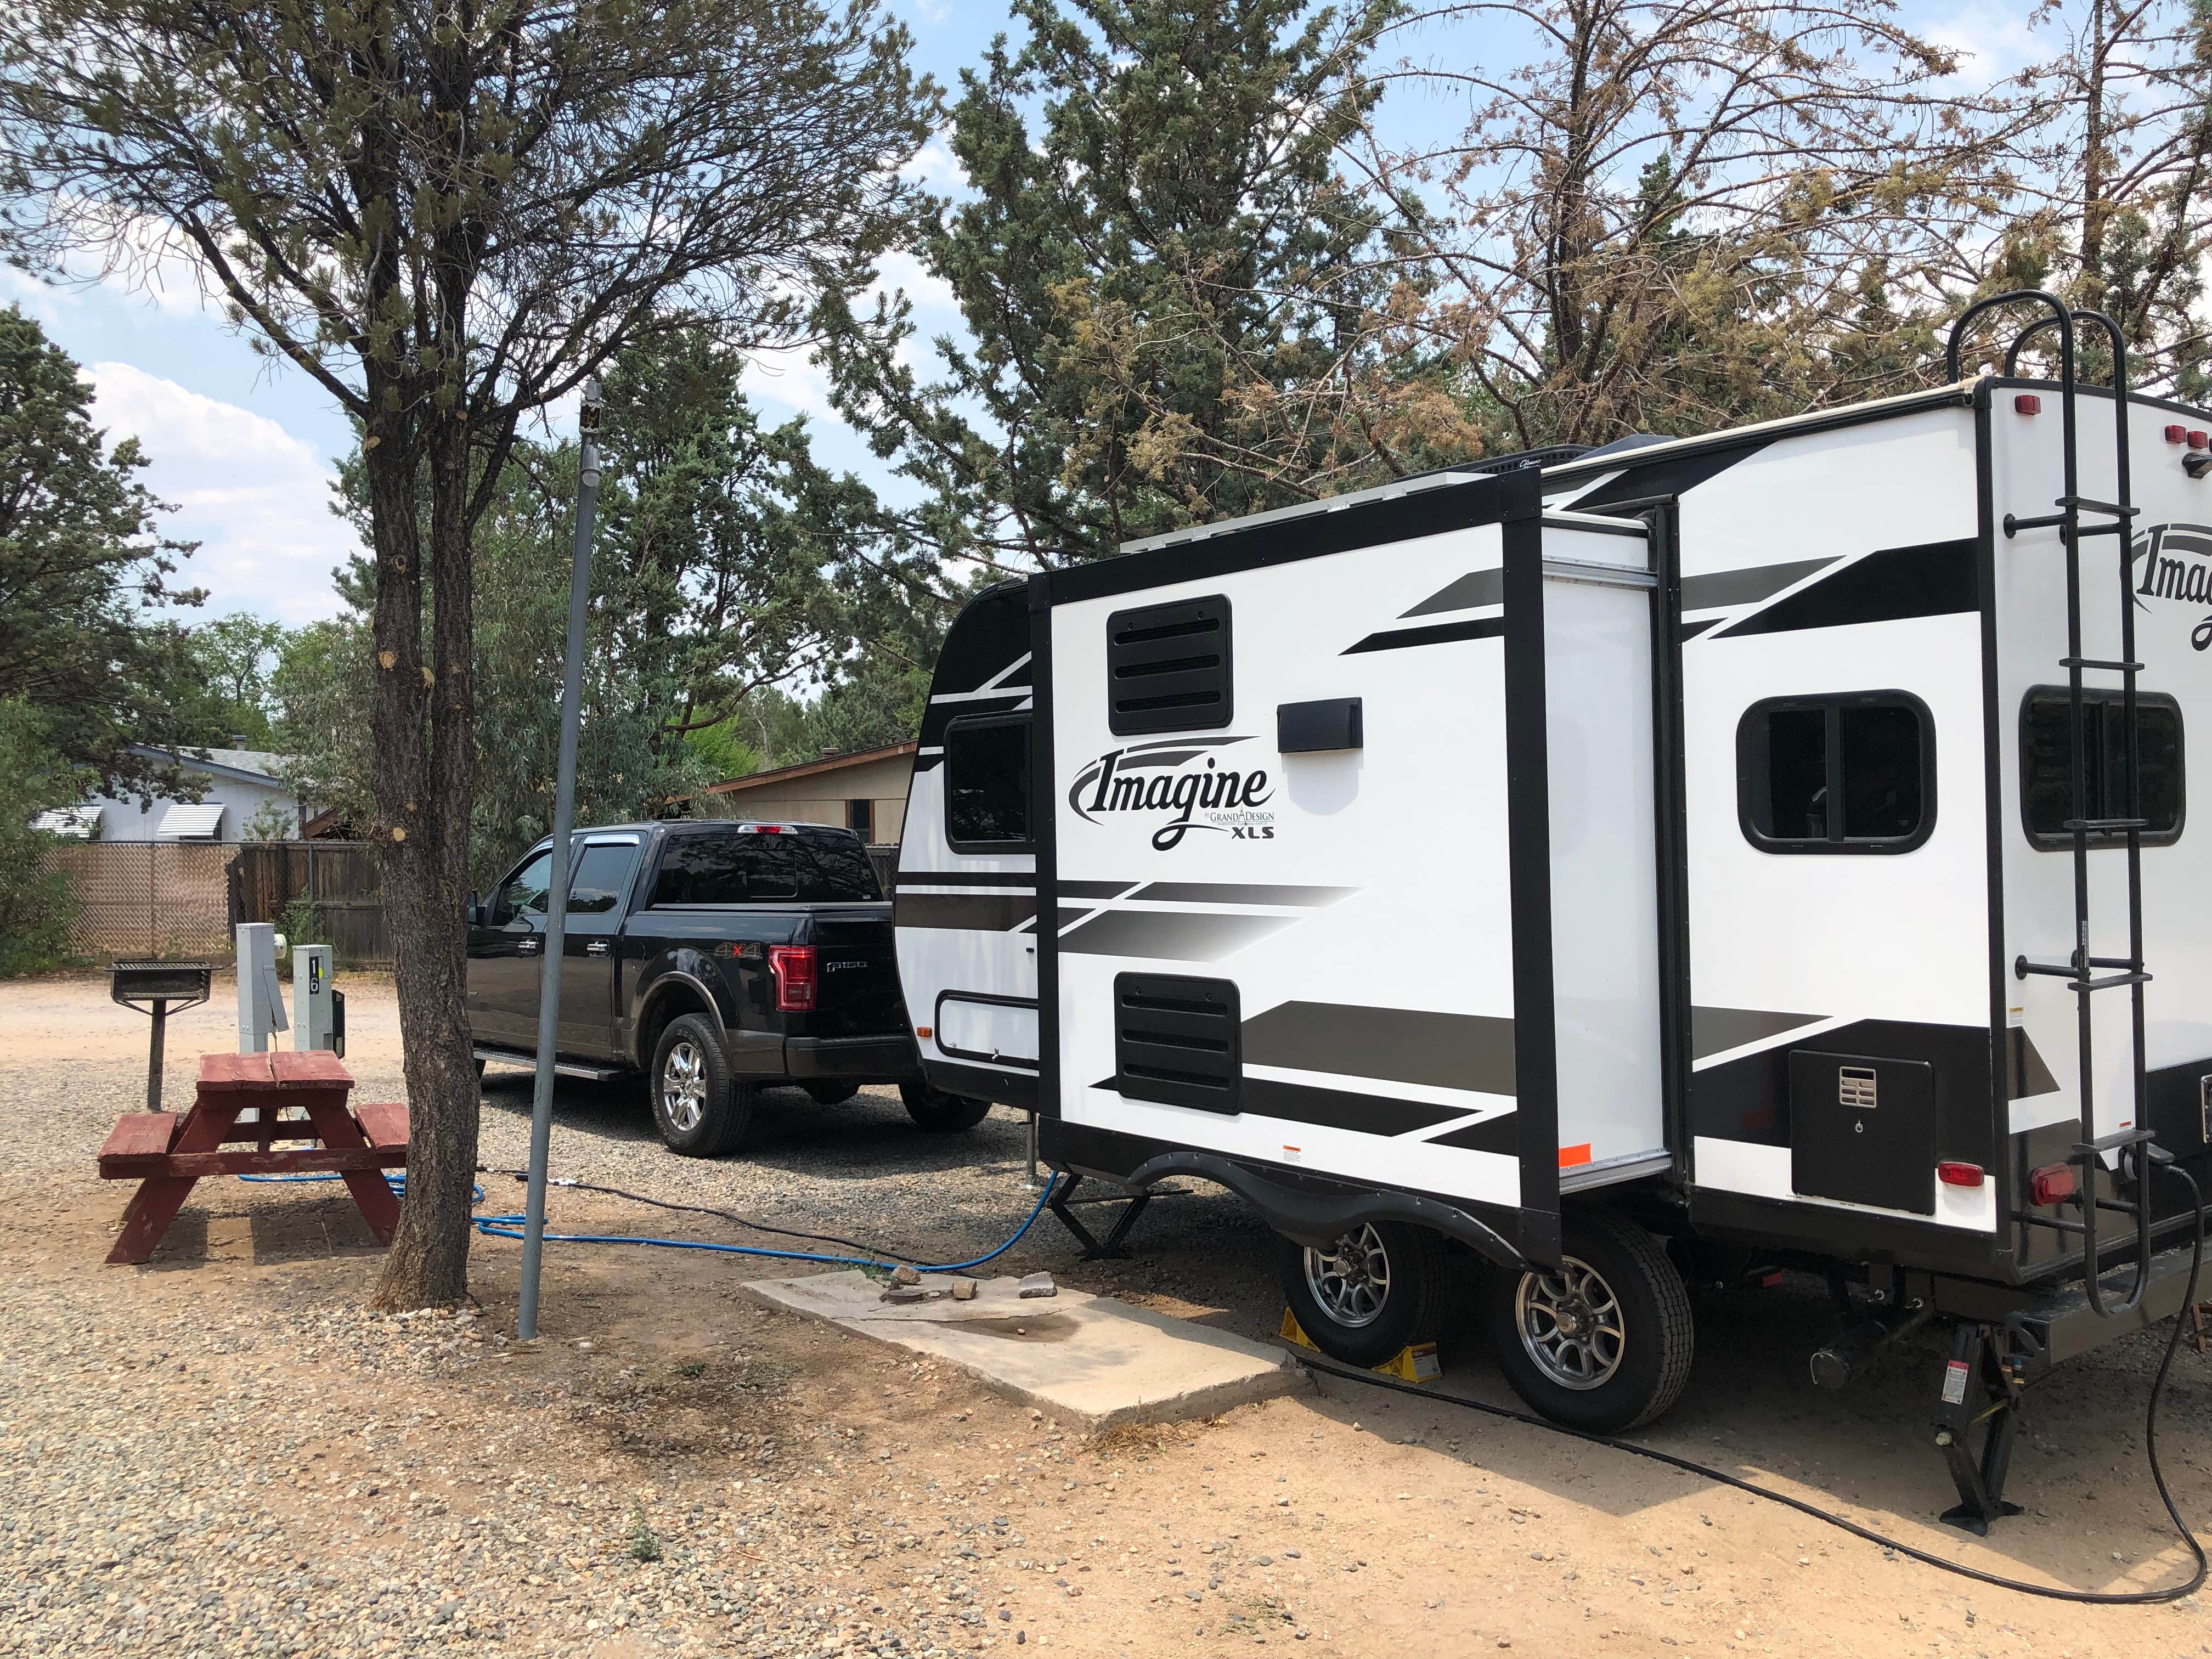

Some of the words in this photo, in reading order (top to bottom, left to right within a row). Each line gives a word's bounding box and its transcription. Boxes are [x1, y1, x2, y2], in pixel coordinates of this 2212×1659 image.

[1087, 749, 1276, 851] Imagine
[1210, 812, 1238, 821] GRAND
[1246, 811, 1274, 821] DESIGN
[1232, 827, 1274, 839] XLS
